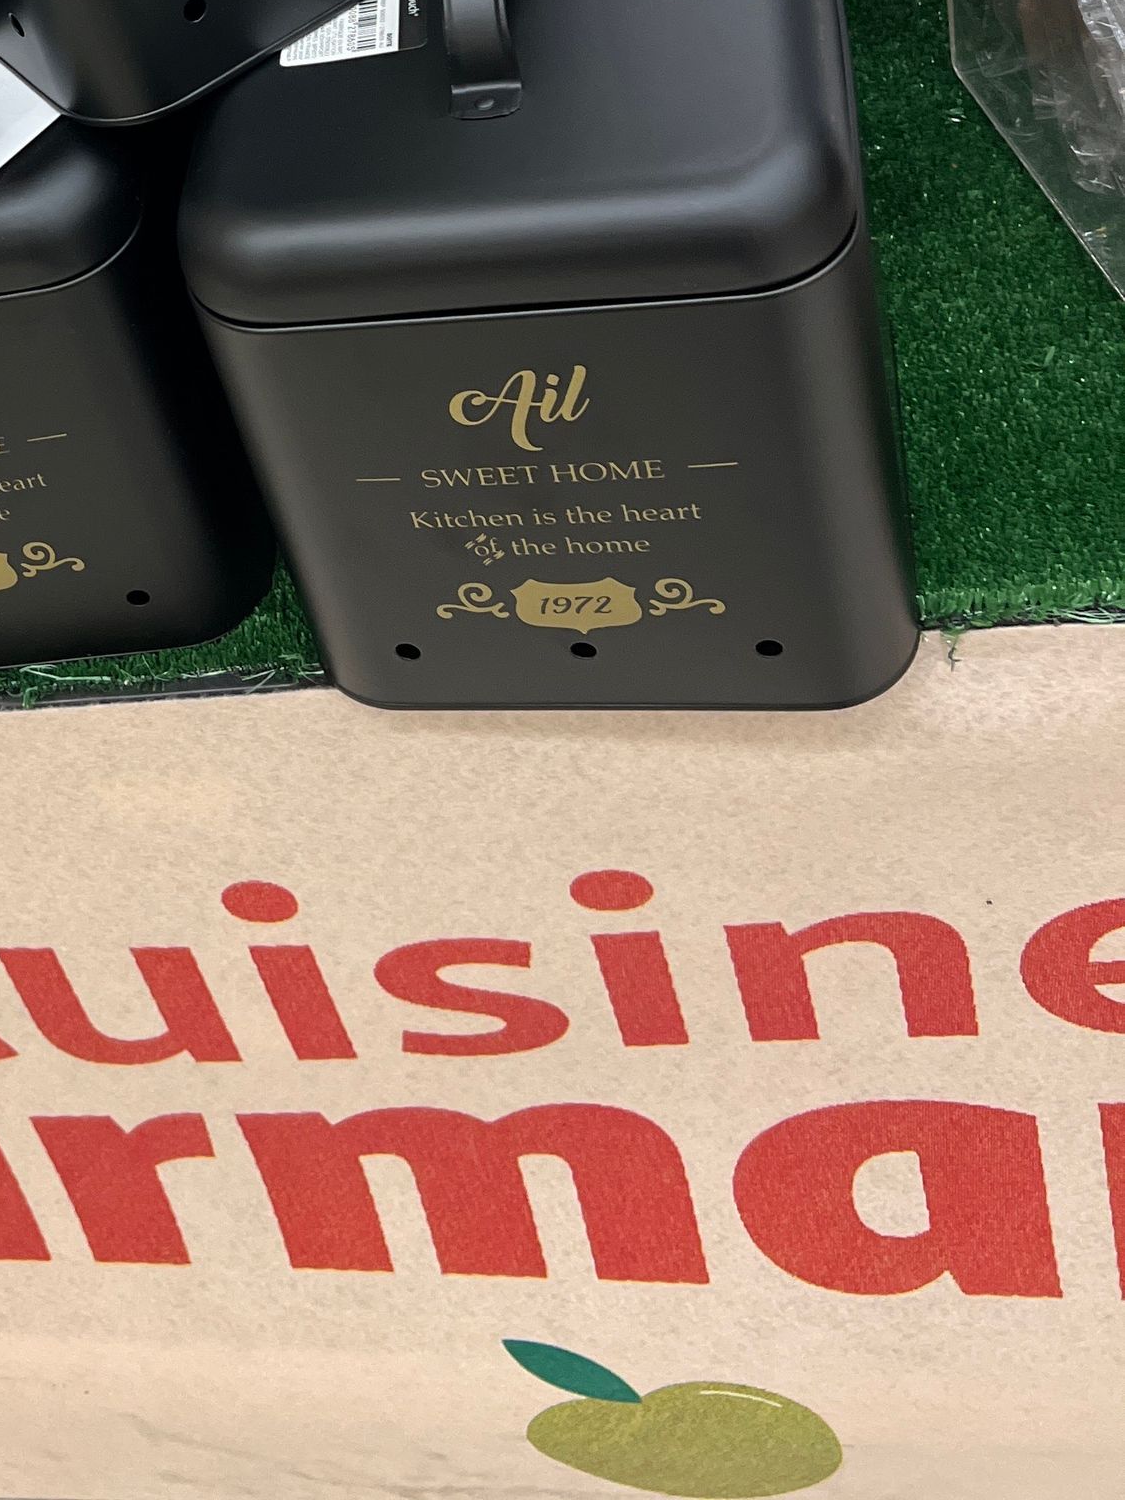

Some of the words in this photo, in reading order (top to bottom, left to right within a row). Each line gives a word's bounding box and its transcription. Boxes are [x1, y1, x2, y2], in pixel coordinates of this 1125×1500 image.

[448, 364, 590, 452] Ail
[420, 465, 538, 489] SWEET
[551, 459, 665, 484] HOME
[410, 508, 524, 530] Kitchen
[533, 506, 557, 525] is
[565, 505, 613, 525] the
[619, 502, 702, 522] heart
[511, 537, 557, 556] the
[564, 536, 651, 555] home
[539, 595, 613, 616] 1972
